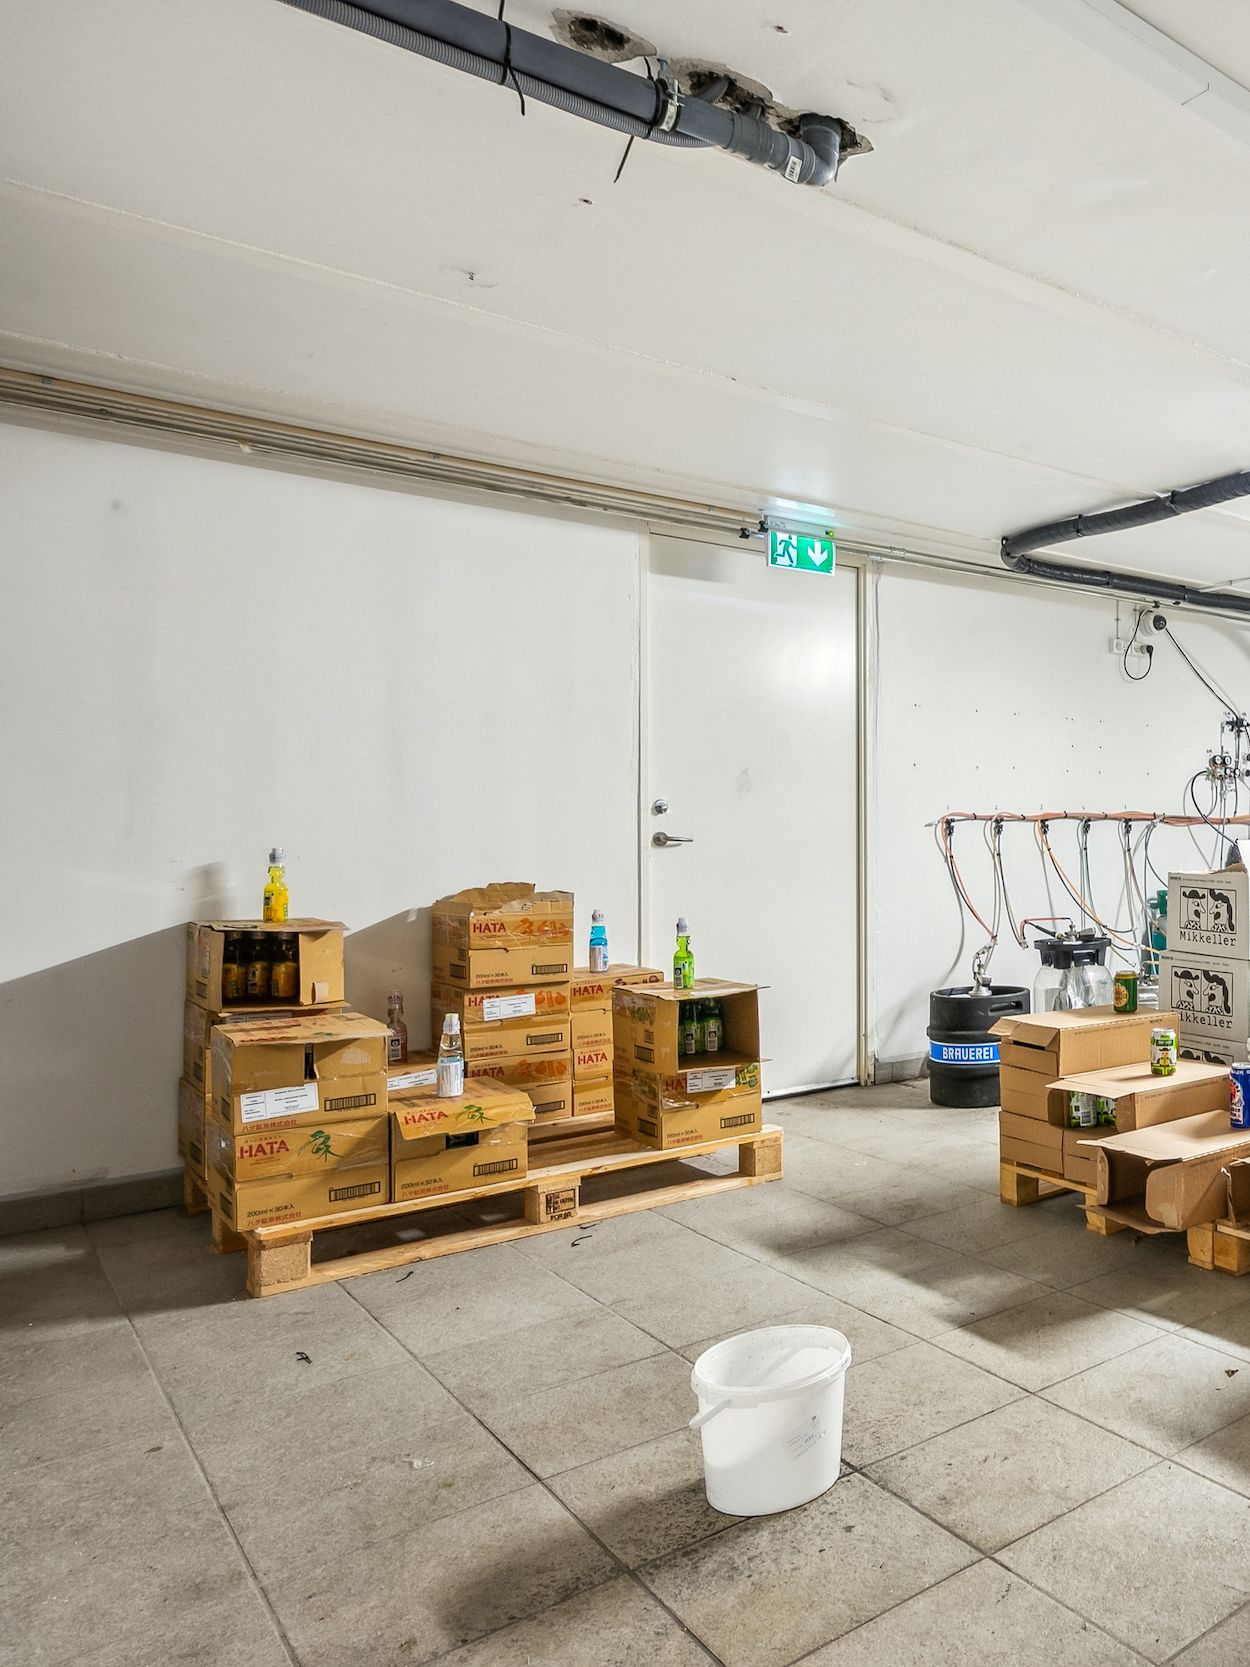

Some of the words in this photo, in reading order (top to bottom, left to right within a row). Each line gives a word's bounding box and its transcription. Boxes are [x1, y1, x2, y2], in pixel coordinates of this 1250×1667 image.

[473, 922, 506, 933] HATA
[1180, 931, 1236, 946] Mikkeller
[573, 984, 604, 997] HATA
[1172, 1010, 1233, 1028] ikkeller
[577, 1052, 608, 1065] HATA
[942, 1047, 994, 1060] BRAUEREI
[471, 1066, 505, 1078] HATA
[403, 1111, 449, 1125] HATA
[239, 1140, 290, 1159] HATA
